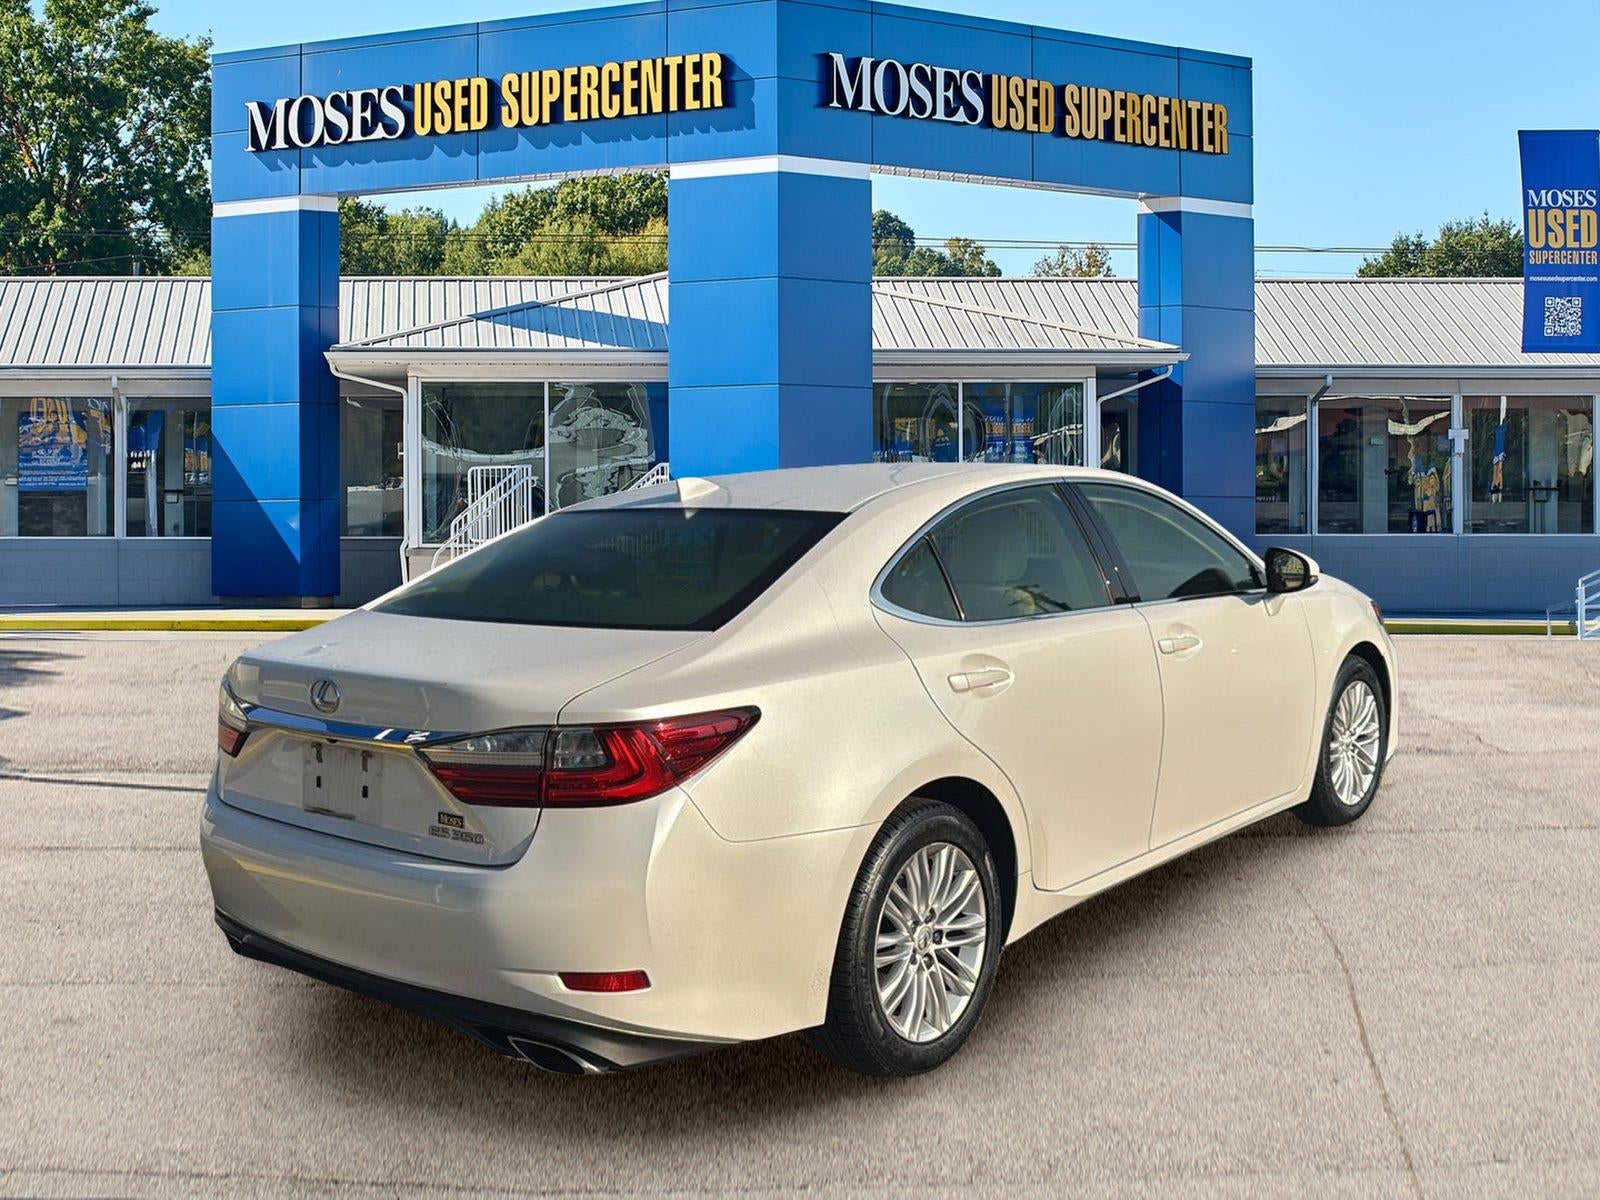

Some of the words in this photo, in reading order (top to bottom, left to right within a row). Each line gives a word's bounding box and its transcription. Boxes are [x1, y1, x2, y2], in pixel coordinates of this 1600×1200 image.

[244, 85, 405, 152] MOSES
[412, 76, 488, 137] USED
[500, 52, 724, 129] SUPERCENTER
[828, 52, 984, 125] MOSES
[991, 74, 1056, 134] USED
[1064, 83, 1229, 155] SUPERCENTER
[1527, 189, 1597, 208] MOSES
[1527, 209, 1598, 249] USED
[1529, 250, 1598, 265] SUPERCENTER
